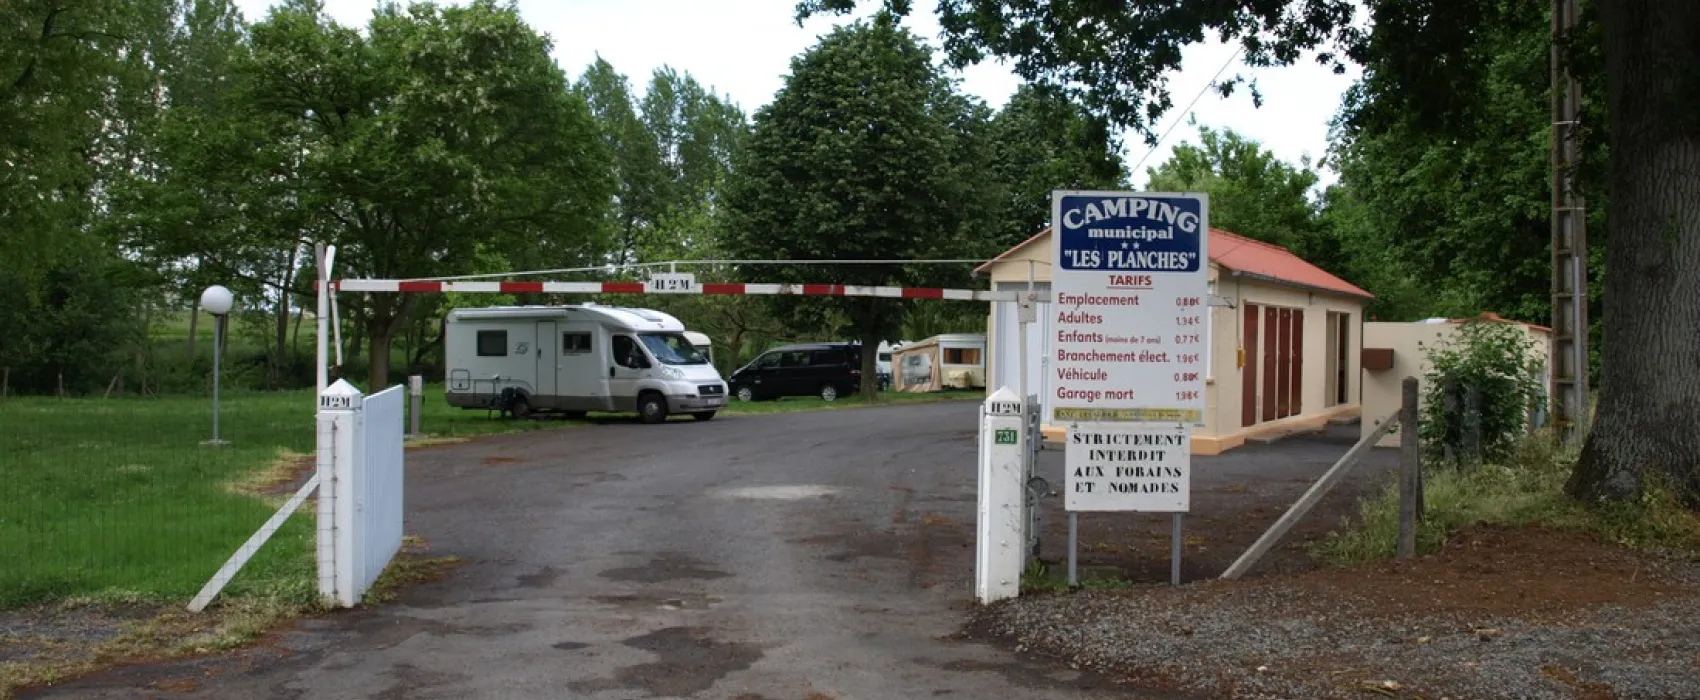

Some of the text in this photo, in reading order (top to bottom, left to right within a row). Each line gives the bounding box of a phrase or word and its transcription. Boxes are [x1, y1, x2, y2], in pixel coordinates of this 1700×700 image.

[1063, 198, 1199, 233] CAMPING
[1088, 226, 1174, 241] municipal
[1064, 250, 1196, 269] "LES PLANCHES"
[1109, 275, 1152, 286] TARIFS
[1058, 292, 1139, 308] Emplacement
[1057, 311, 1103, 324] Adultes
[1058, 330, 1103, 343] Enfants
[1105, 335, 1128, 344] (moins
[1130, 335, 1139, 343] de
[1146, 336, 1161, 344] ans)
[1057, 350, 1135, 362] Branchement
[1139, 350, 1170, 363] élect.
[1057, 368, 1107, 381] Véhicule
[1057, 386, 1101, 402] Garage
[1105, 389, 1134, 400] mort
[997, 431, 1015, 442] 731
[1073, 433, 1186, 446] STRICTEMENT
[1089, 449, 1166, 462] INTERDIT
[1074, 466, 1182, 478] AUX FORAINS
[1075, 482, 1179, 493] ET NOMADES
